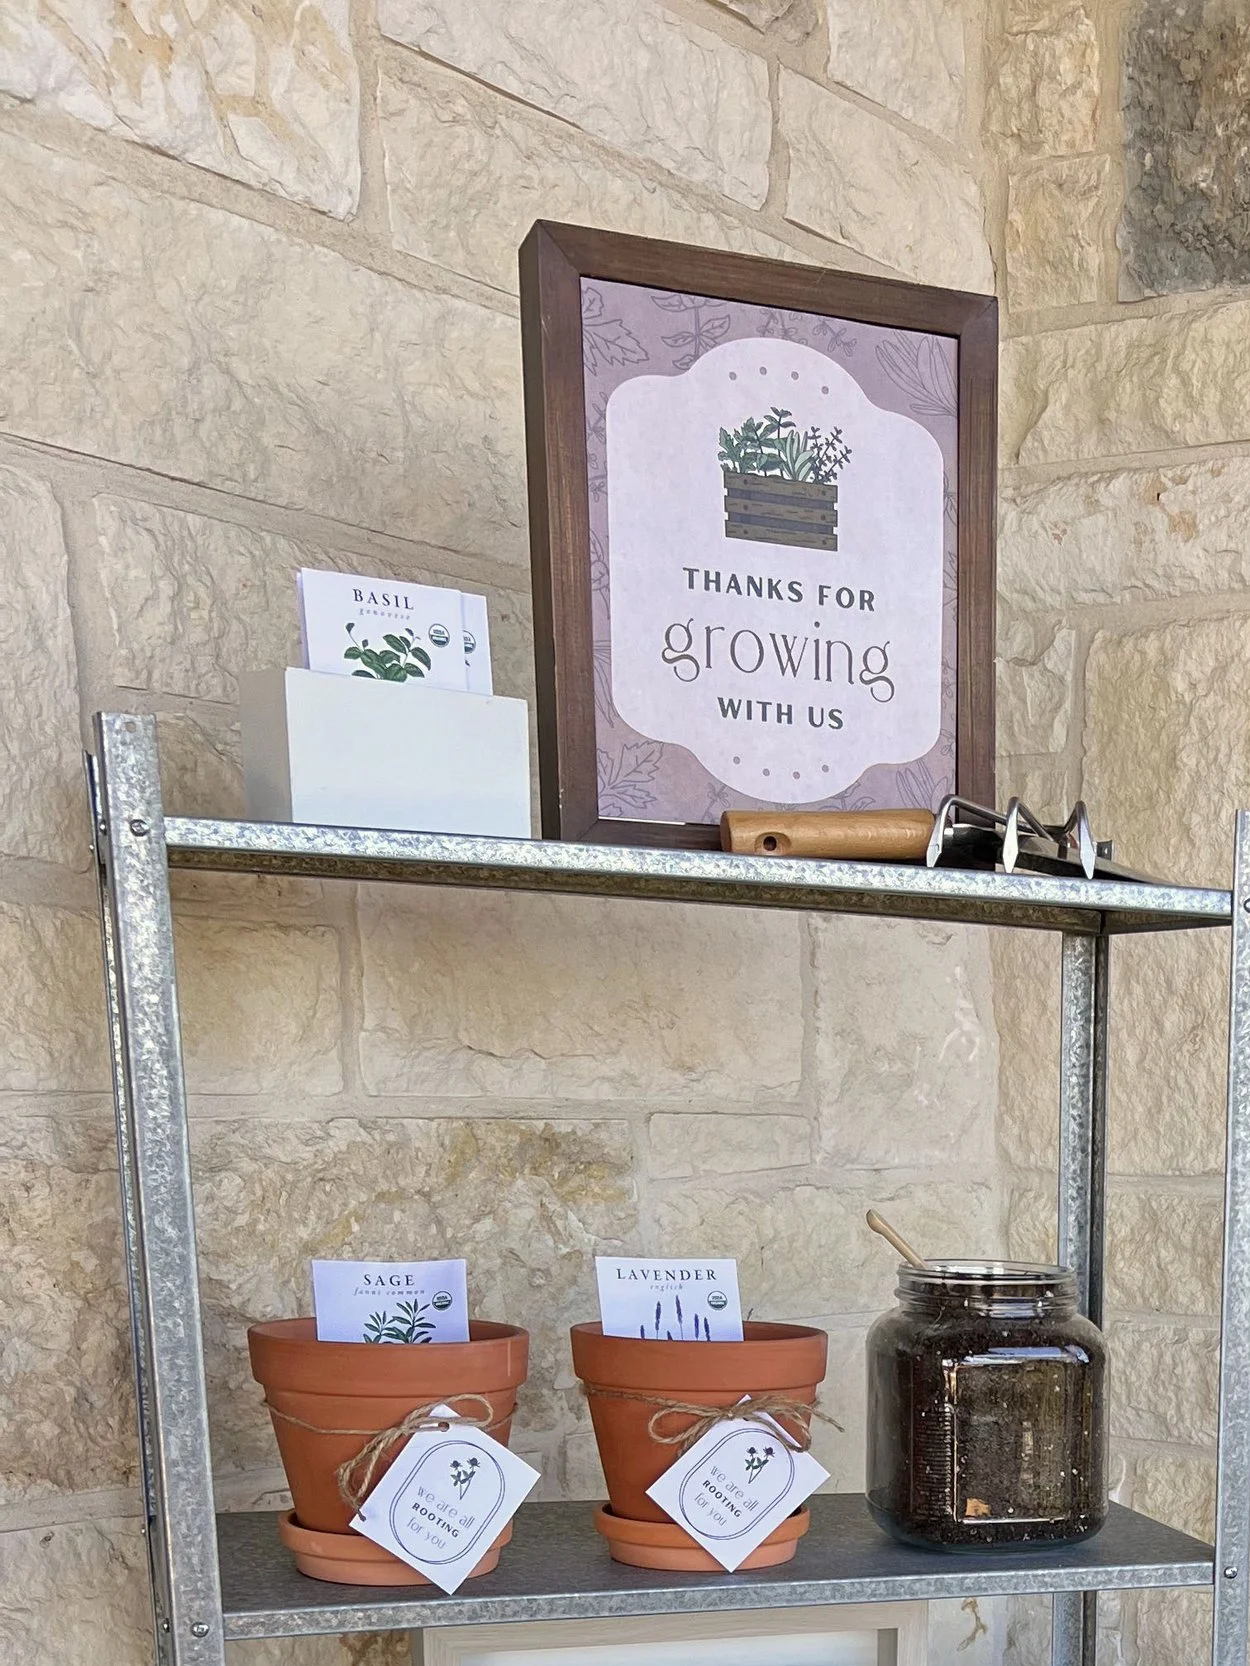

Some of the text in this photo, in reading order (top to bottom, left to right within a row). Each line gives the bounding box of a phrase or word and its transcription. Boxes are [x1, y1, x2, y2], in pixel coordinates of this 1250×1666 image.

[352, 588, 415, 611] BASIL
[682, 566, 876, 612] THANKS FOR
[661, 617, 896, 704] growing
[716, 696, 844, 730] WITH US
[363, 1273, 416, 1287] SAGE
[615, 1267, 718, 1281] LAVENDER
[702, 1479, 742, 1518] ROOTING
[710, 1465, 760, 1512] we are all
[411, 1502, 460, 1538] ROOTING
[417, 1485, 476, 1529] we are all
[694, 1492, 728, 1527] for you
[406, 1516, 447, 1550] for you
